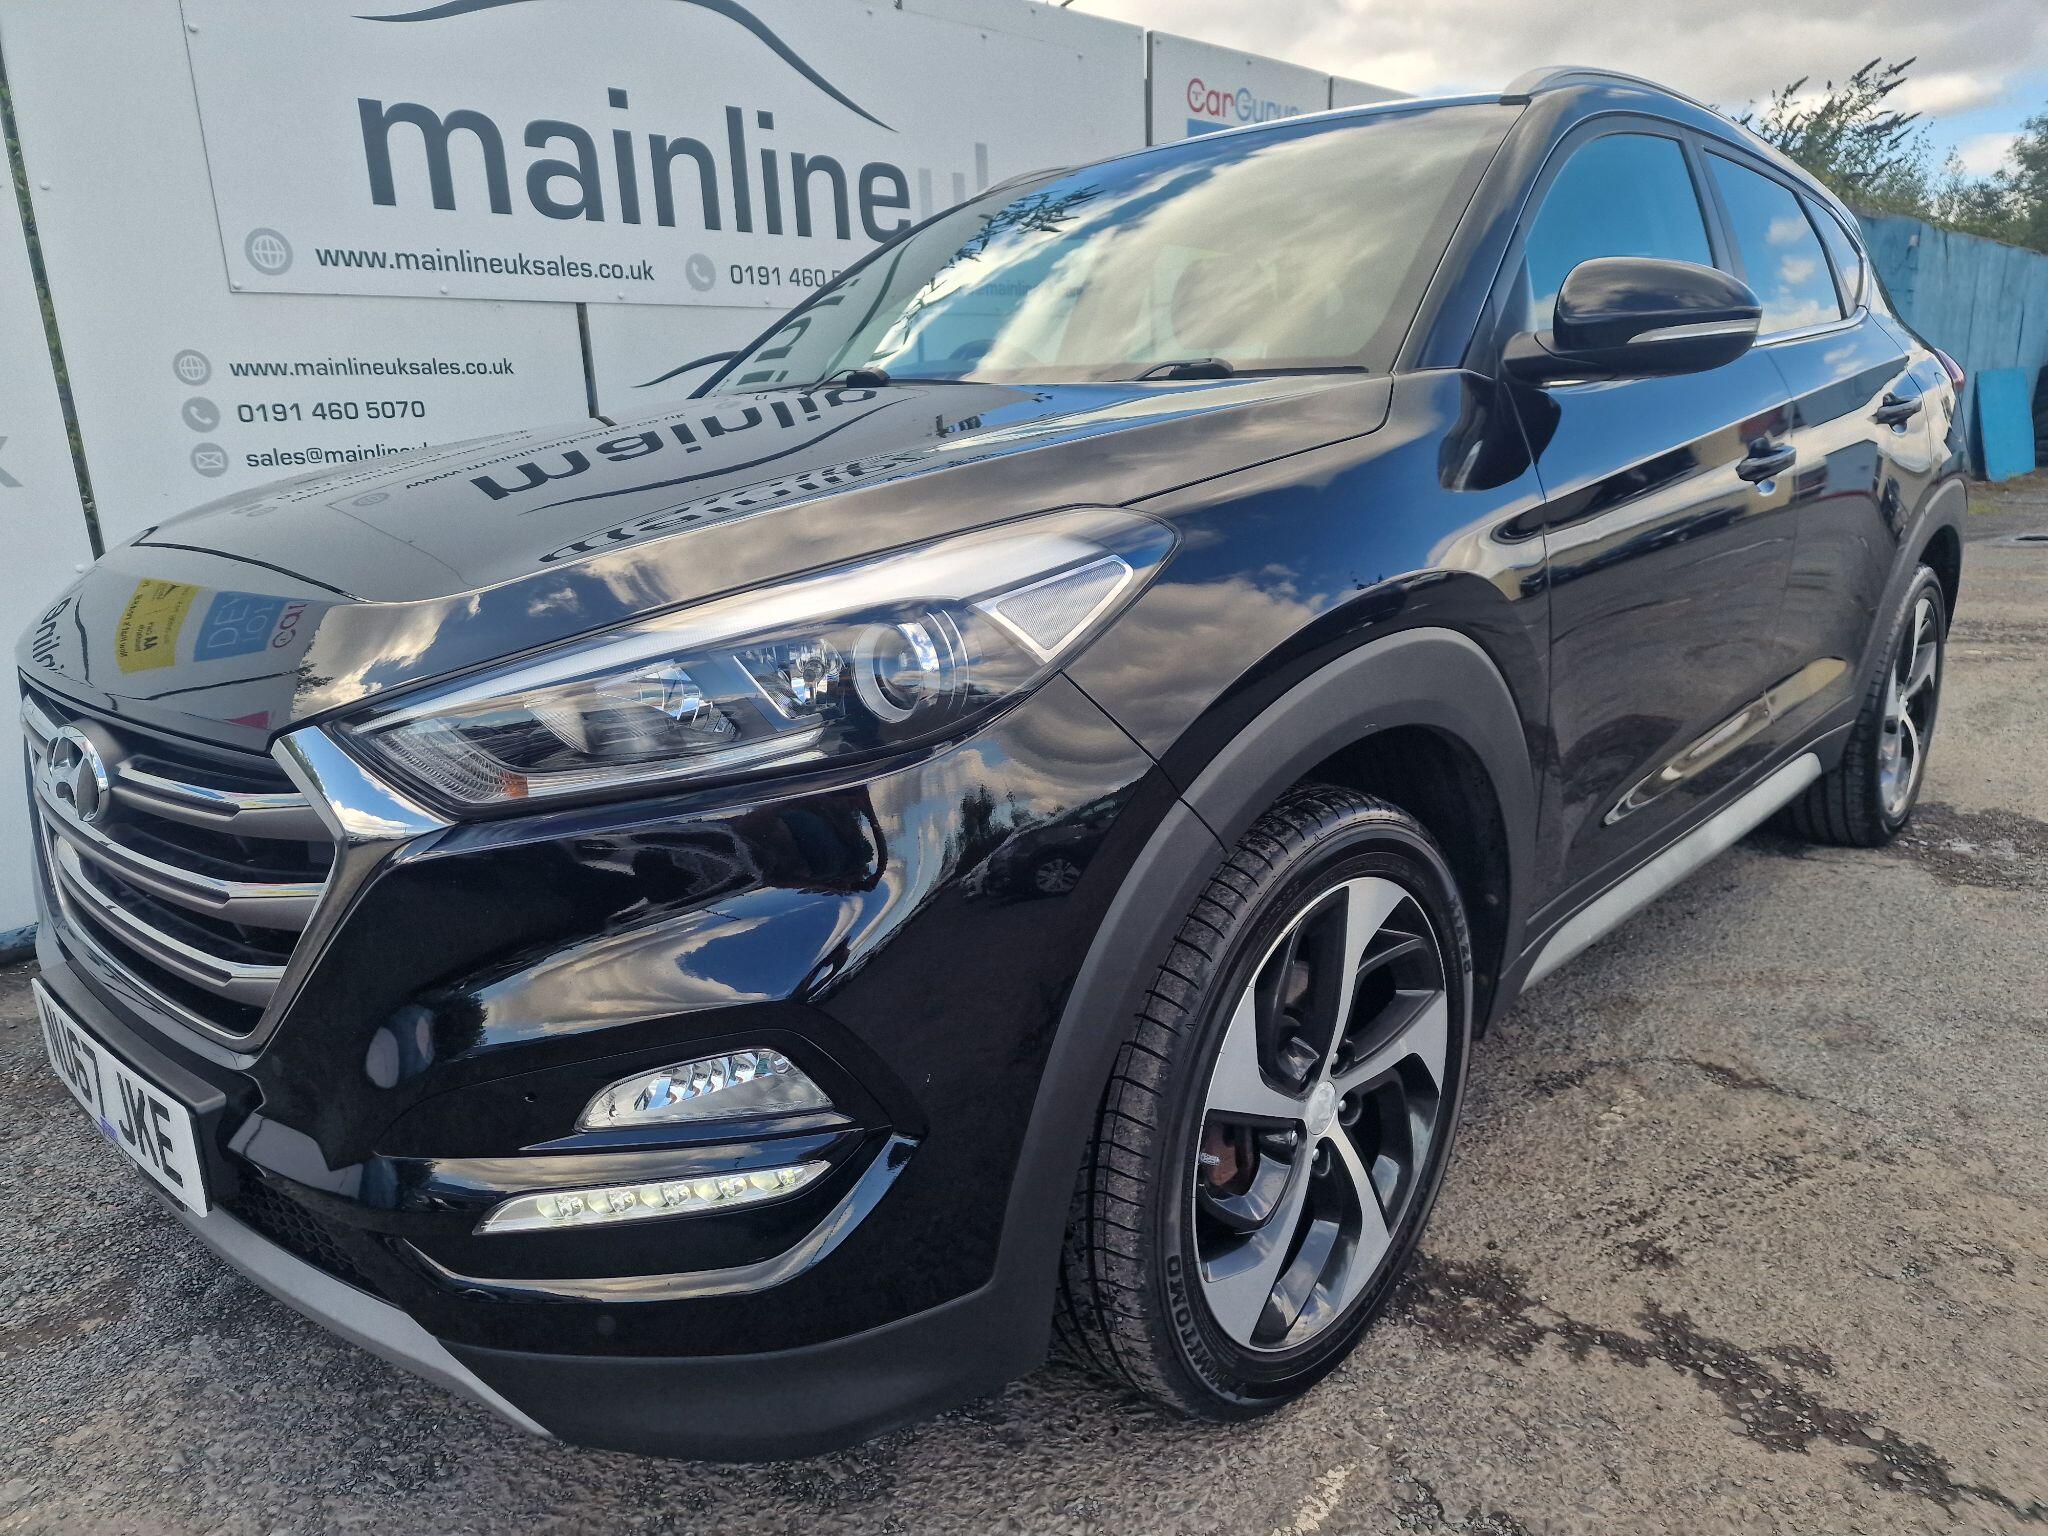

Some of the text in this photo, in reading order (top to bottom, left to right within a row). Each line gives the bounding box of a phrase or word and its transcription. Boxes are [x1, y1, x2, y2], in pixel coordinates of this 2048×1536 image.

[315, 248, 655, 281] www.mainlineuksales.co.uk
[730, 264, 781, 286] 0191
[789, 268, 826, 288] 460
[230, 358, 514, 377] www.mainlineuksales.co.uk
[237, 400, 426, 423] 0191 460 5070
[40, 995, 184, 1188] NU67 JKE
